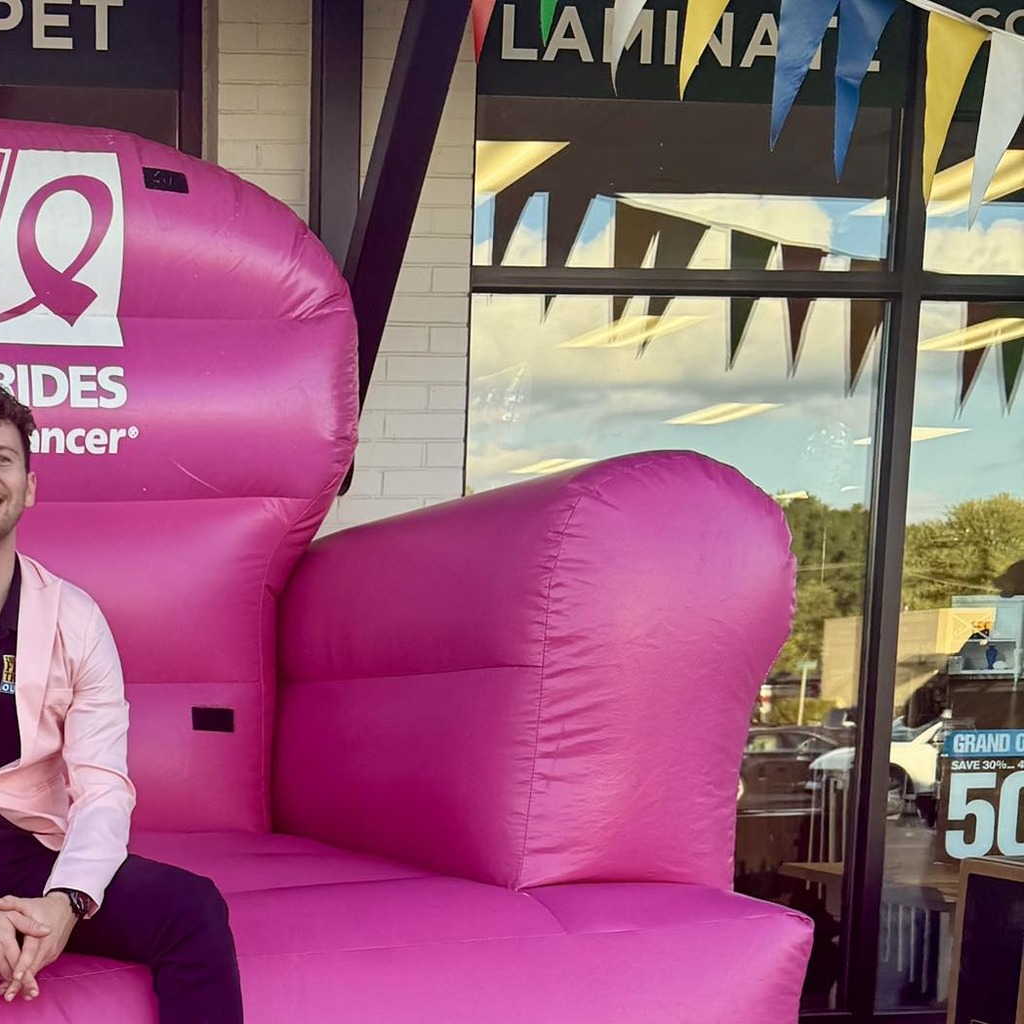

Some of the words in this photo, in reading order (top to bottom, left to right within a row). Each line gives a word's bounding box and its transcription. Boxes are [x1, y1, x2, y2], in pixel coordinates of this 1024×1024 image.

[501, 4, 880, 72] LAMINA
[953, 732, 1011, 753] GRAND
[951, 760, 981, 770] SAVE
